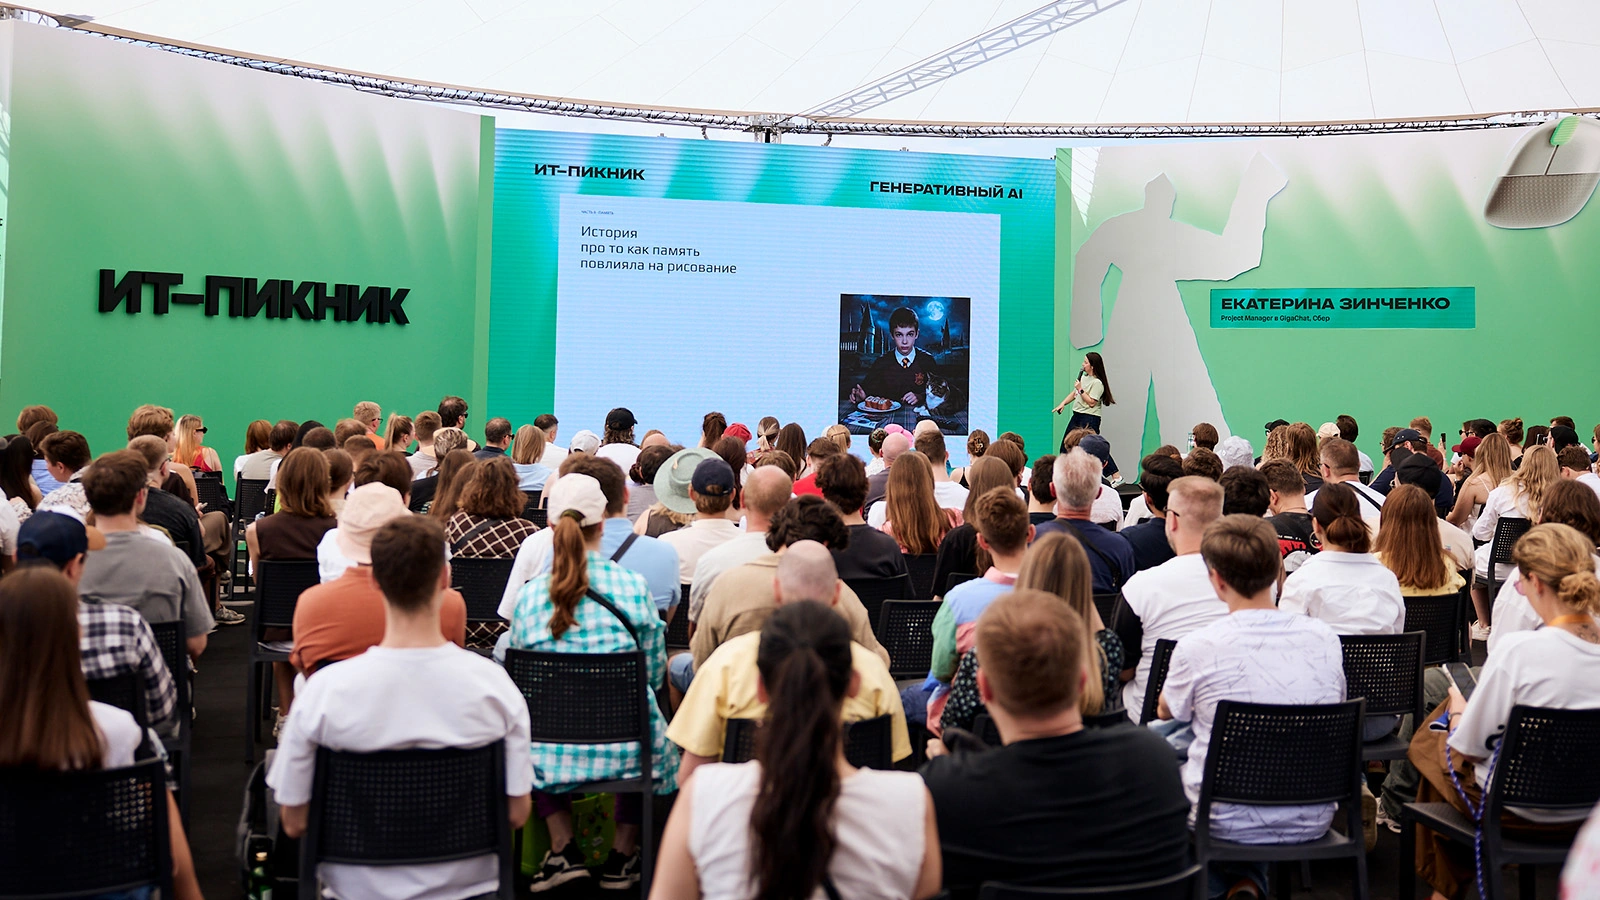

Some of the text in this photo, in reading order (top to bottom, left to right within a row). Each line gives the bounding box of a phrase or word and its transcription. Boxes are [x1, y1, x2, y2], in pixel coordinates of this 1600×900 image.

[534, 163, 645, 181] ИТ-ПИКНИК
[870, 181, 1023, 199] ГЕНЕРАТИВНЫЙ AI
[581, 225, 638, 241] История
[580, 243, 700, 257] про то как память
[580, 259, 738, 274] повлияла на рисование
[98, 269, 411, 325] ИТ-ПИКНИК
[1221, 297, 1451, 310] ЕКАТЕРИНА ЗИНЧЕНКО
[1220, 315, 1243, 323] Project
[1279, 315, 1312, 323] GigaChat,
